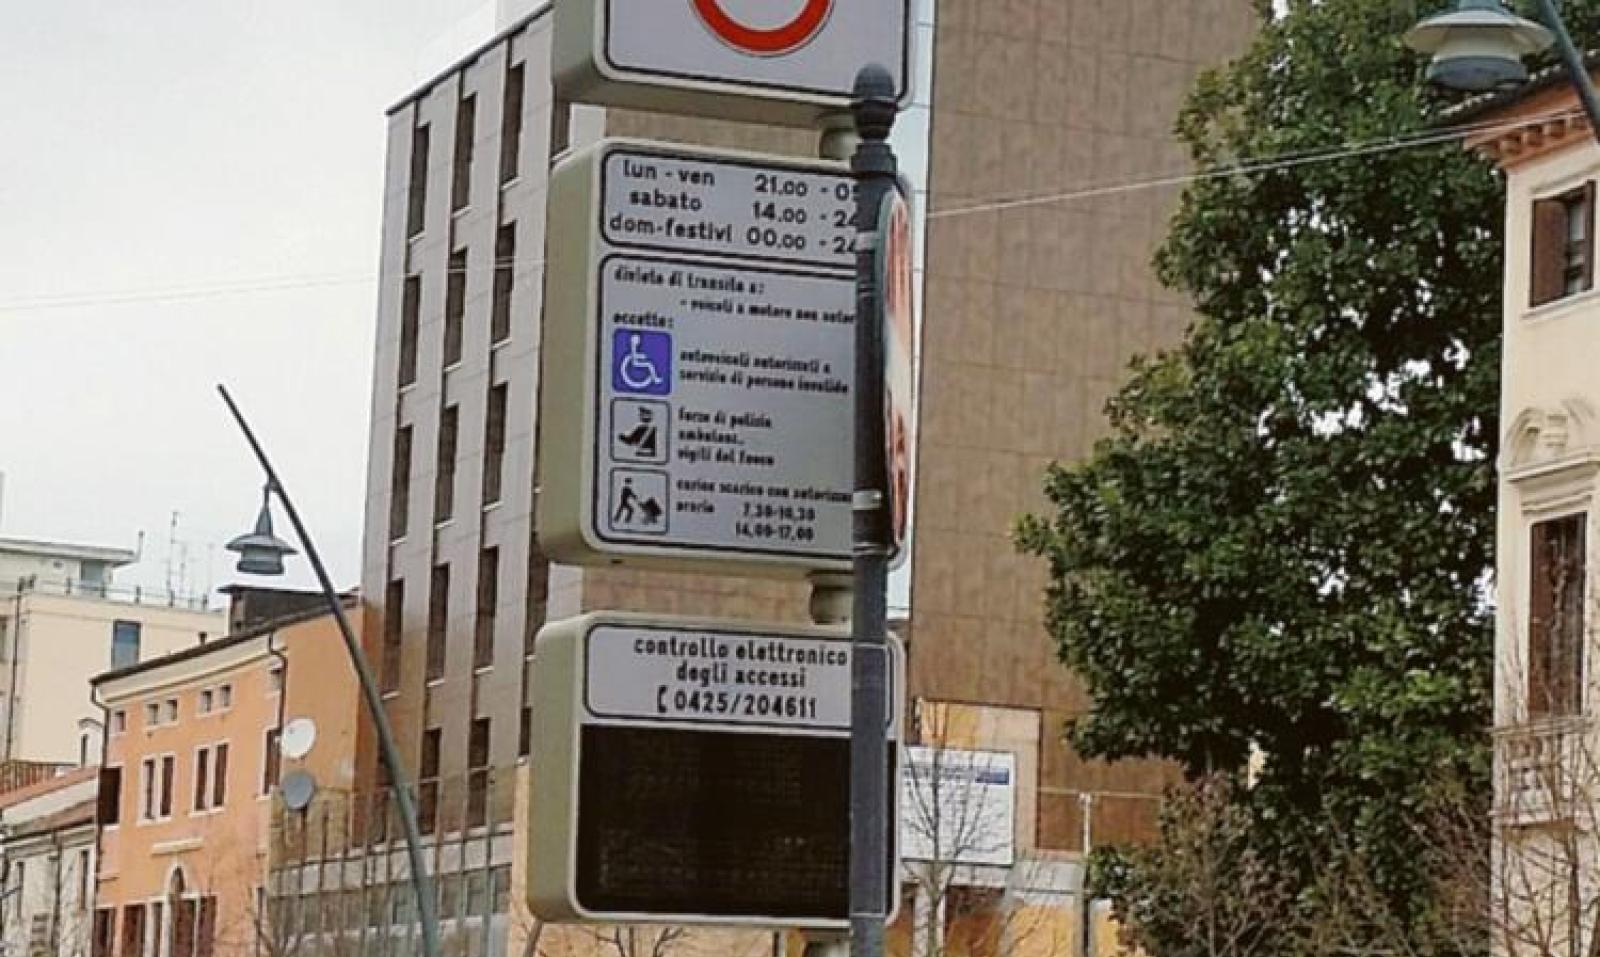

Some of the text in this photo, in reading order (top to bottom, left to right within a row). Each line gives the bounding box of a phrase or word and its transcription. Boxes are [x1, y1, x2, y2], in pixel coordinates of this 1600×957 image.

[624, 160, 657, 179] lun
[679, 170, 715, 185] ven
[755, 173, 807, 197] 21.00
[630, 188, 702, 211] sabato
[753, 201, 806, 224] 14.00
[610, 212, 732, 242] dom-festivi
[747, 226, 806, 250] 00.00
[633, 636, 848, 666] controllo elettronico
[676, 660, 806, 688] degli accessi
[674, 690, 817, 719] 0425/204611
